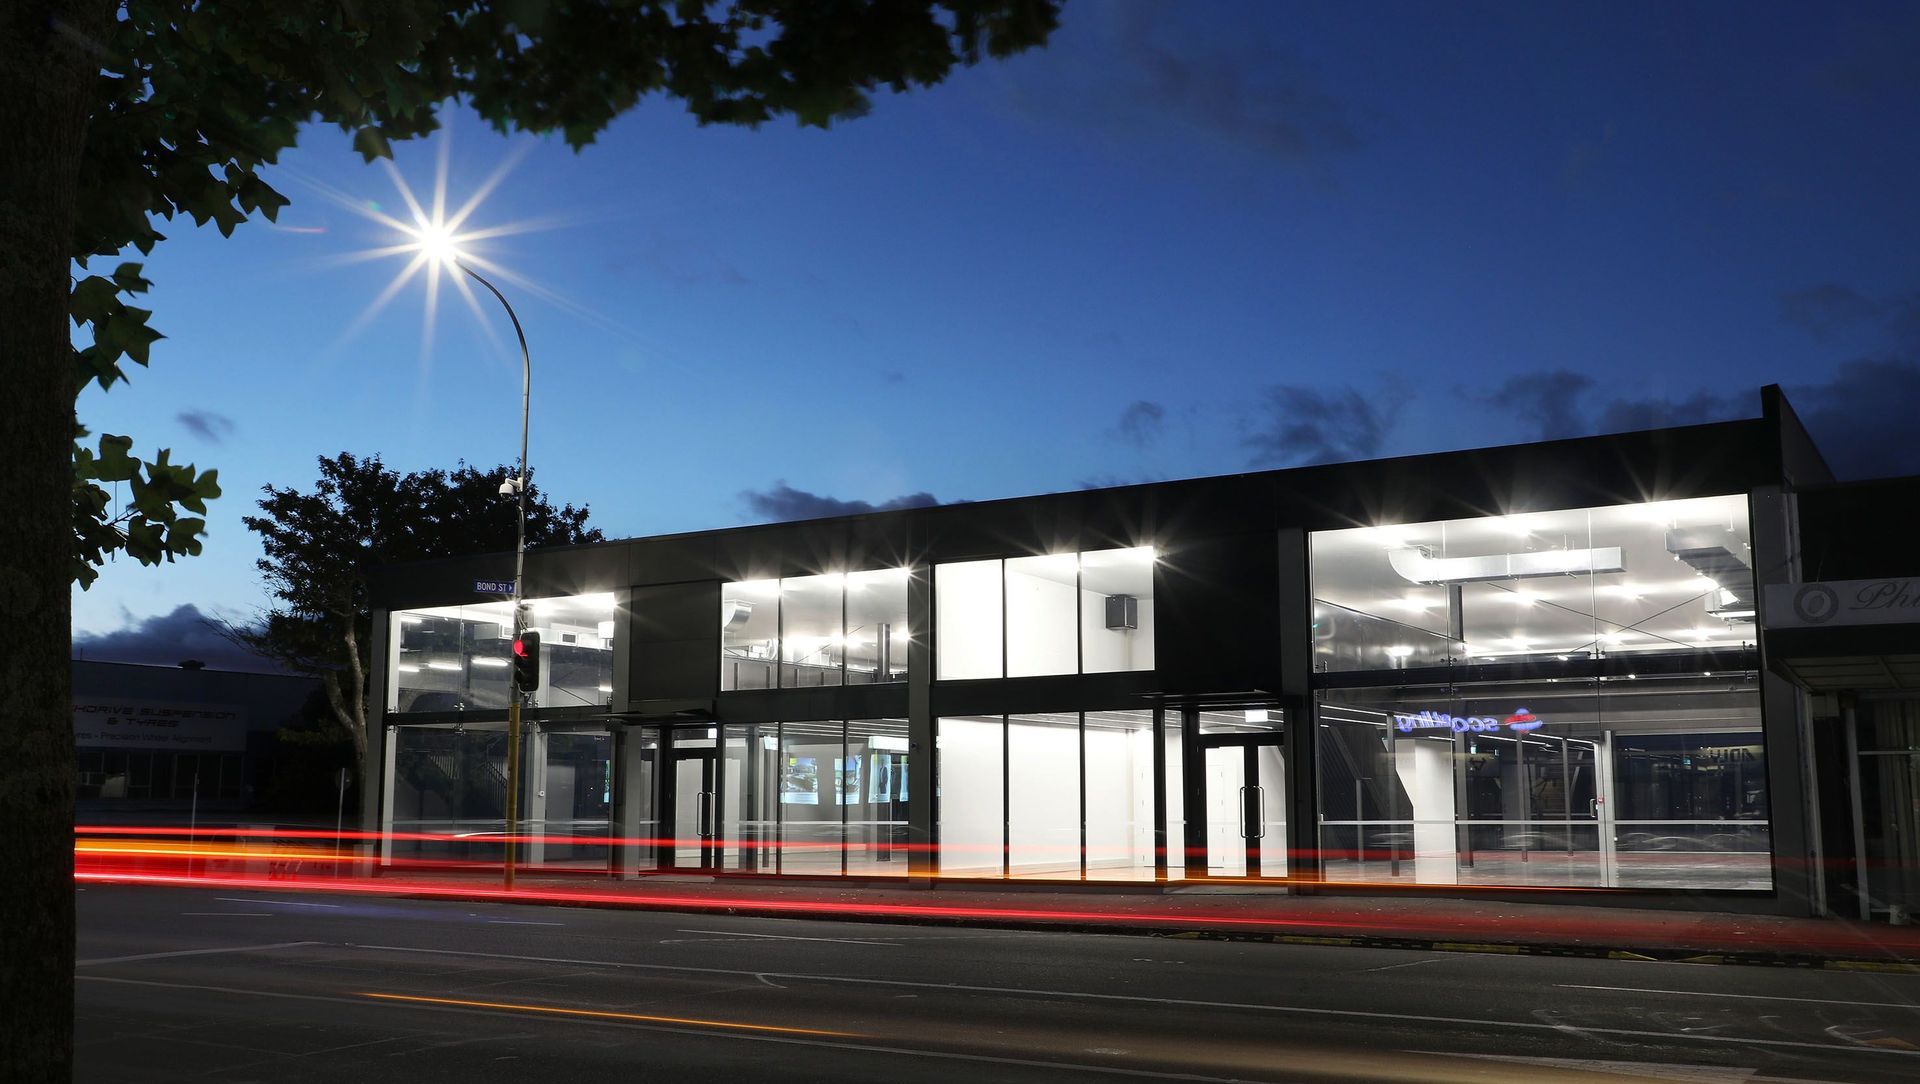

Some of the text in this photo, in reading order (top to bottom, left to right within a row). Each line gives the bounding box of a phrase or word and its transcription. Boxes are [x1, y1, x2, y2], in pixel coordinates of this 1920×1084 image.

[476, 581, 507, 592] BOND ST
[73, 704, 135, 716] HDRIVE
[127, 718, 181, 728] TYRES
